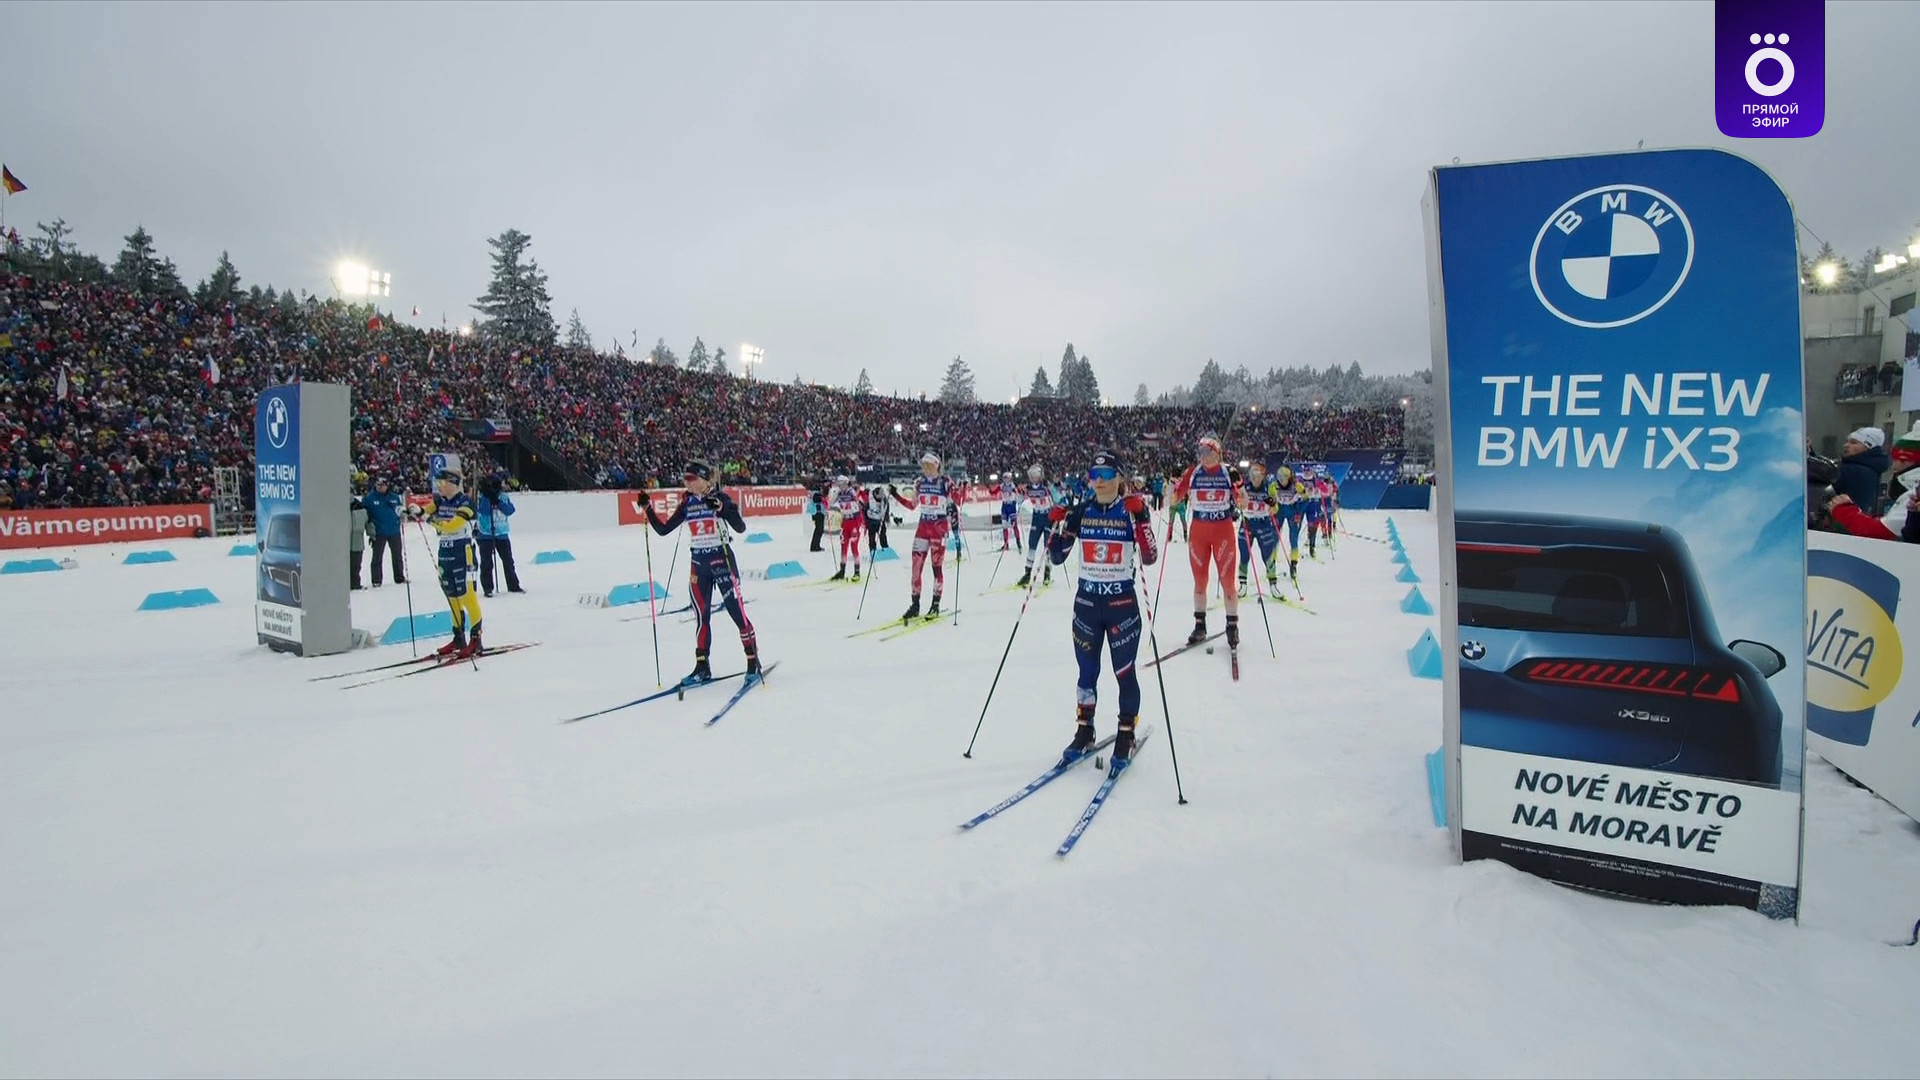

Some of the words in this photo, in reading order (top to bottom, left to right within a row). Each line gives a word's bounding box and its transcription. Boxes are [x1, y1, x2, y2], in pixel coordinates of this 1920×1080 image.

[1555, 191, 1674, 236] BMW
[1481, 374, 1603, 416] THE
[1620, 372, 1770, 417] NEW
[1477, 426, 1628, 469] BMW
[1643, 426, 1740, 472] iX3
[258, 464, 275, 480] THE
[276, 464, 296, 481] NEW
[260, 482, 280, 499] BMW
[697, 521, 706, 535] 2
[1094, 542, 1108, 561] 3
[1098, 582, 1123, 595] iX3
[1514, 768, 1609, 802] NOVÉ
[1614, 780, 1742, 818] MĚSTO
[1511, 803, 1558, 830] NA
[1568, 811, 1723, 853] MORAVĚ
